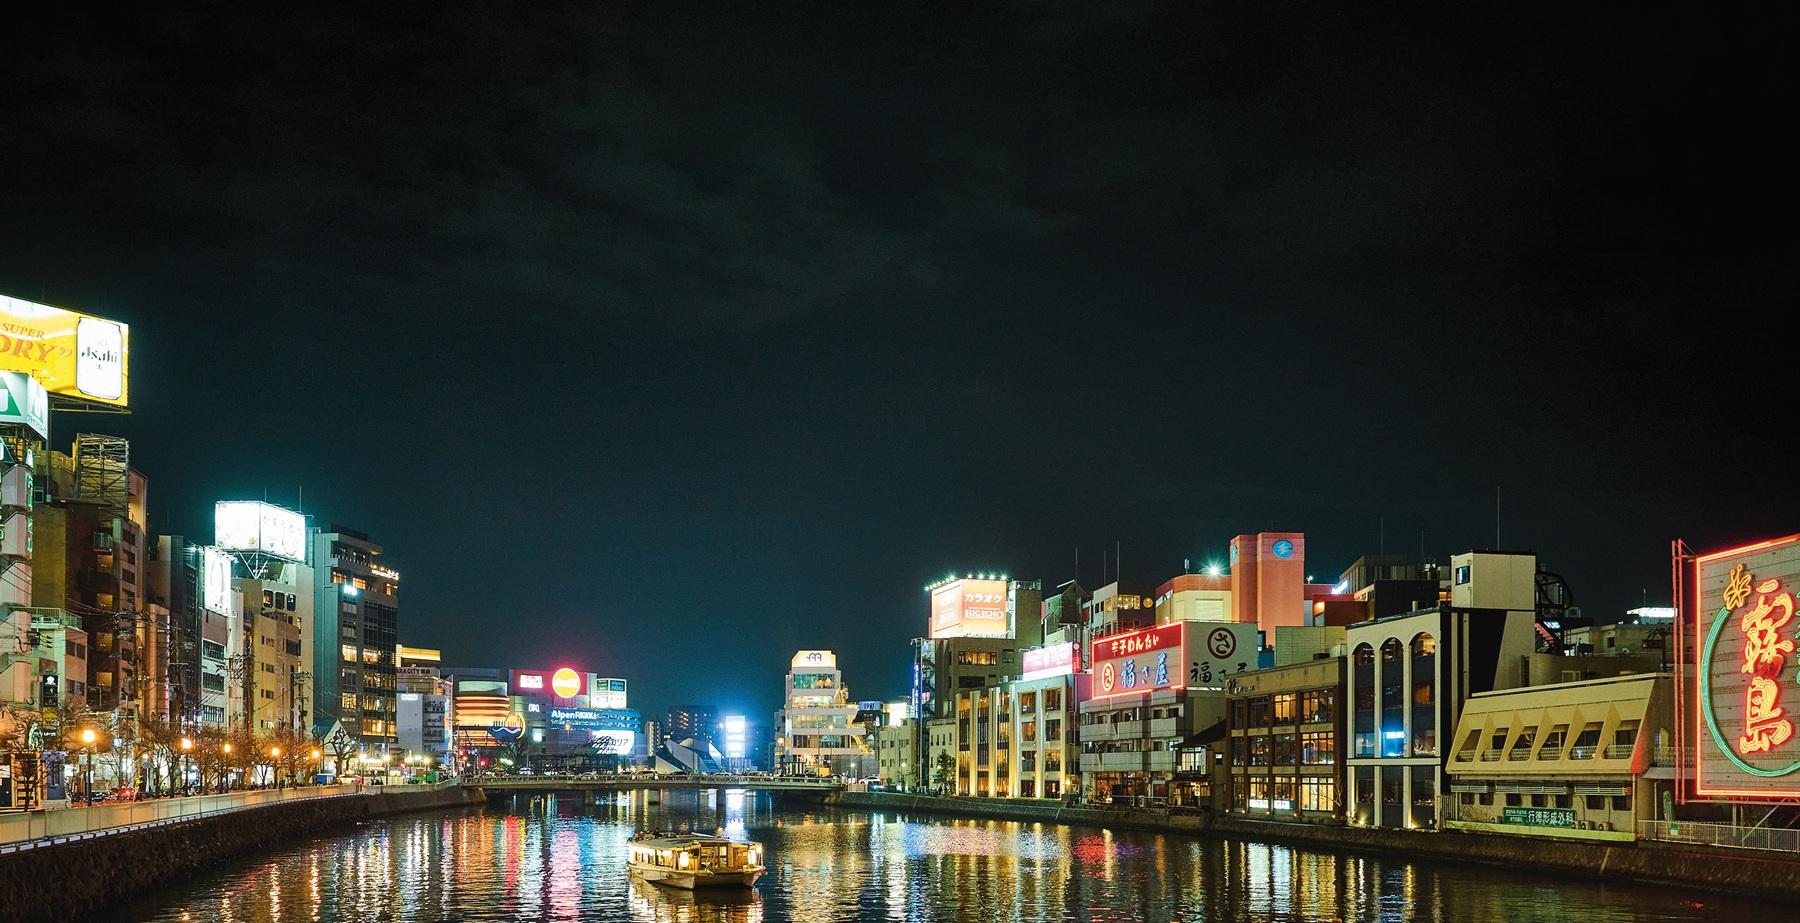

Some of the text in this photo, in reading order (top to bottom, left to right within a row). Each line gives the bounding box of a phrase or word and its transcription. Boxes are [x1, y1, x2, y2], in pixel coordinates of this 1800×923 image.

[2, 323, 44, 338] SUPER
[81, 346, 118, 363] Asahi
[964, 593, 1003, 603] カラオケ
[1120, 651, 1169, 688] 福さ屋
[1528, 811, 1574, 826] 行徳形成外科
